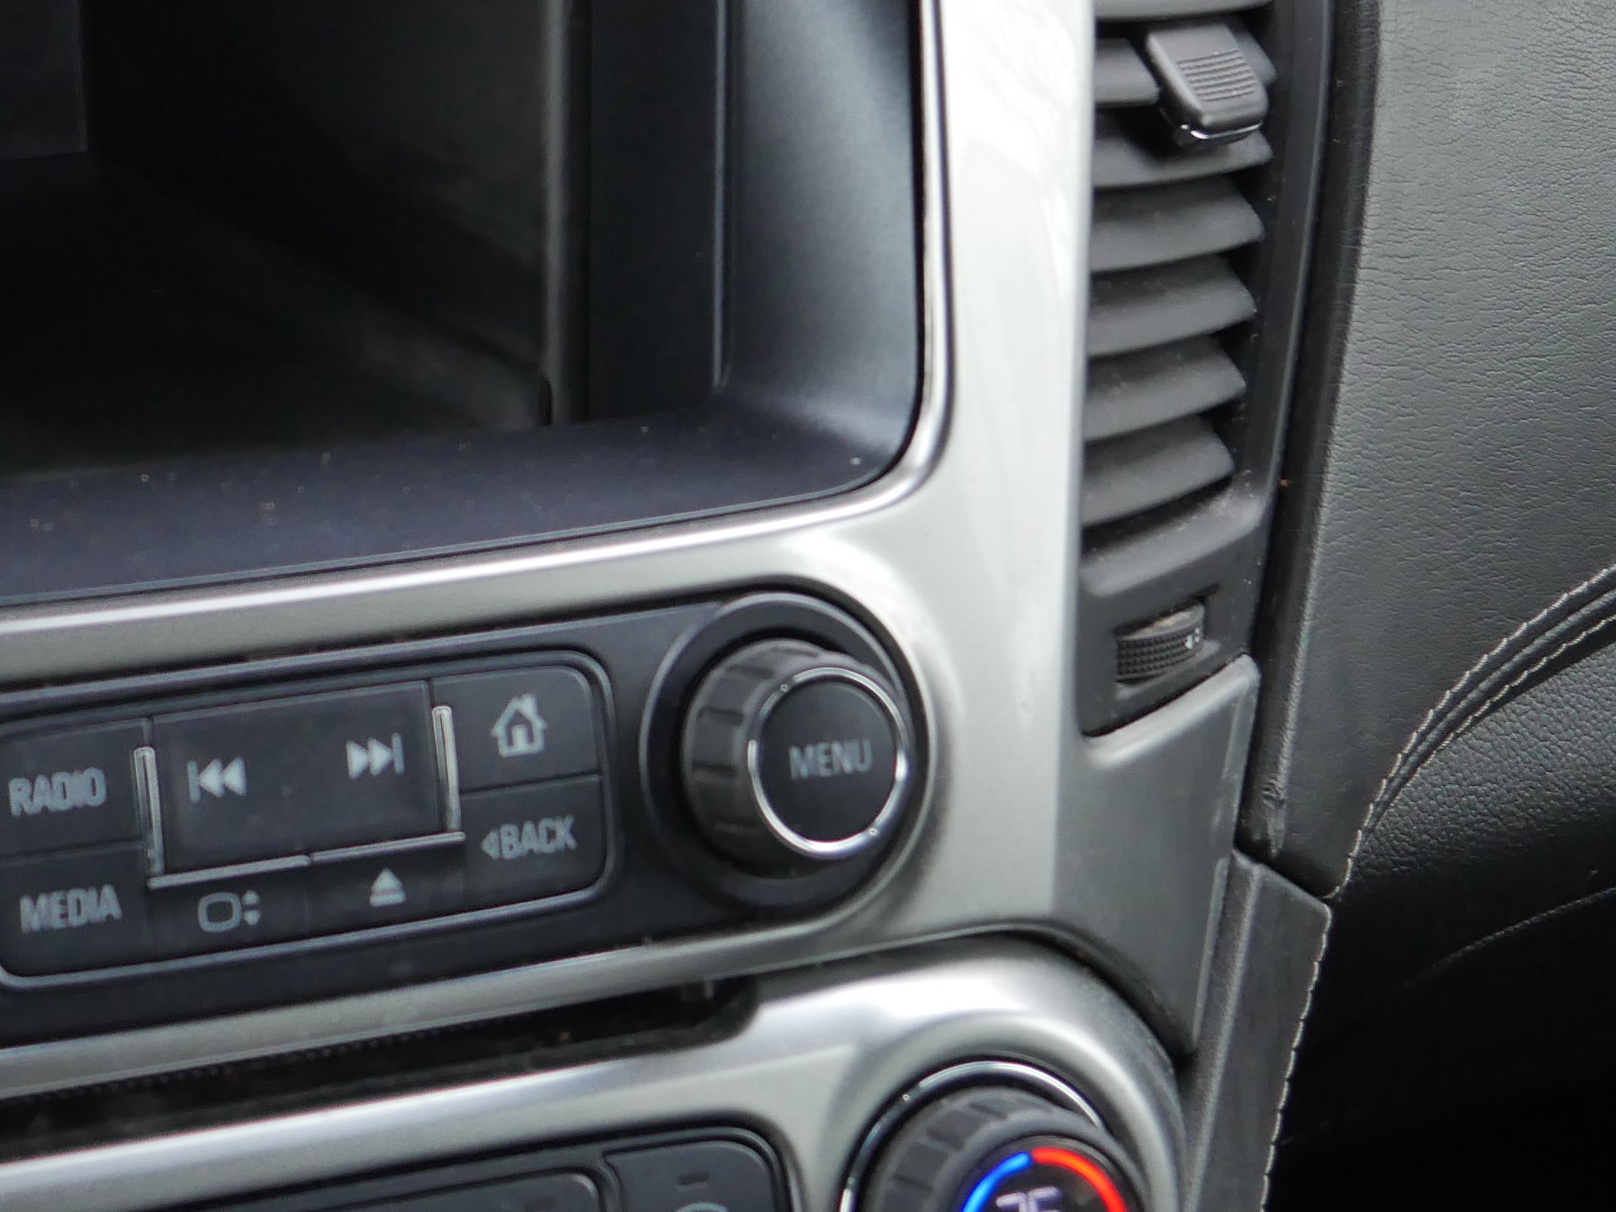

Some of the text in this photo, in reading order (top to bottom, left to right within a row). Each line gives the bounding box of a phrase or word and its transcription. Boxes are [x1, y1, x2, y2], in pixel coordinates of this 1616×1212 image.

[789, 739, 873, 781] MENU
[8, 767, 107, 817] RADIO
[500, 814, 577, 860] BACK
[19, 884, 123, 934] MEDIA
